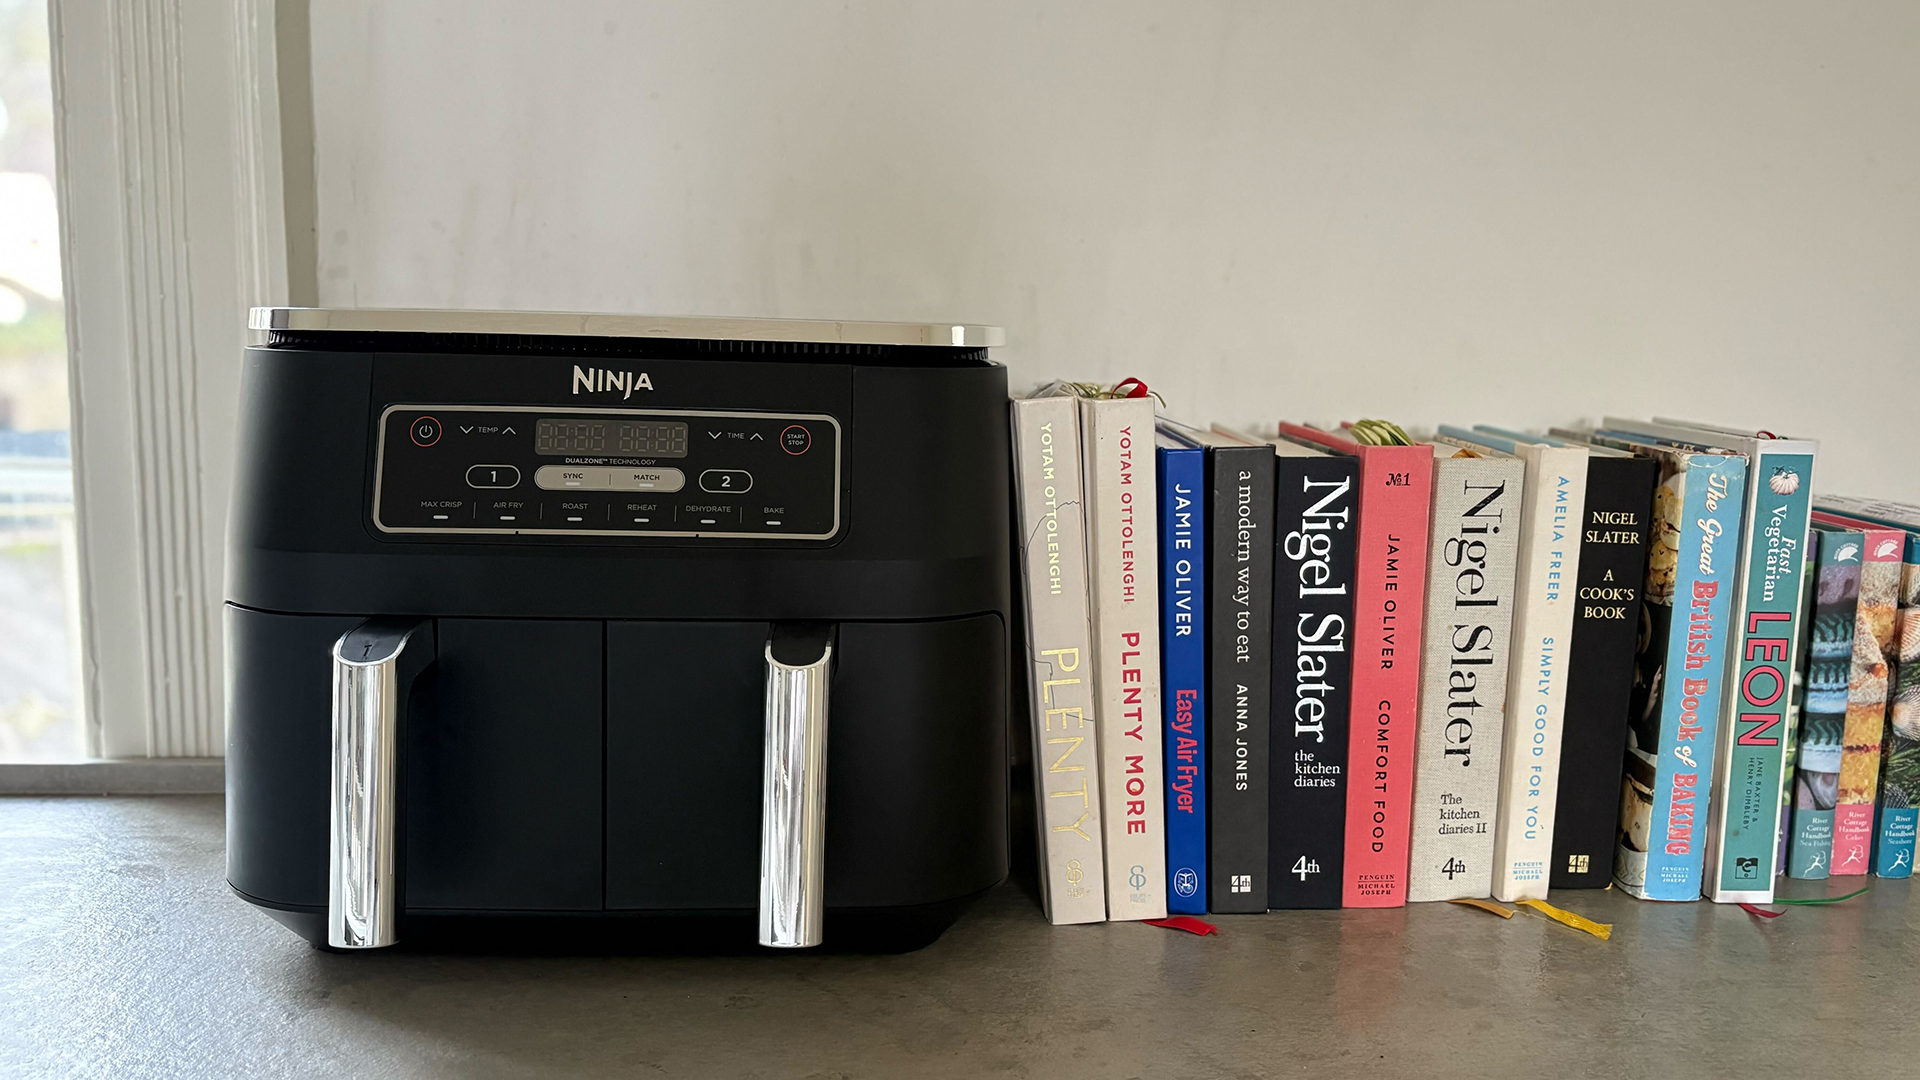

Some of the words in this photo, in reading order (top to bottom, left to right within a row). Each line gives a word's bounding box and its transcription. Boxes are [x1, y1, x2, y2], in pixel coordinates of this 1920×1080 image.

[573, 364, 653, 400] NINJA
[1040, 422, 1055, 480] YOTAM
[1120, 426, 1132, 485] YOTAM
[490, 470, 497, 482] 1
[721, 476, 731, 487] 2
[1239, 470, 1251, 481] a
[1705, 472, 1728, 514] The
[685, 505, 732, 513] DEHYDRATE
[1175, 483, 1192, 550] JAMIE
[1237, 484, 1256, 562] modern
[1552, 476, 1570, 542] AMELIA
[1592, 511, 1638, 526] NIGEL
[1044, 485, 1062, 595] OTTOLENGHI
[1121, 492, 1135, 602] OTTOLENGHI
[1284, 475, 1351, 599] Nigel
[1444, 479, 1506, 611] Nigel
[1585, 530, 1640, 545] SLATER
[1696, 518, 1723, 576] Great
[1762, 504, 1788, 602] Vegetarian
[1778, 535, 1797, 575] Fast
[1232, 566, 1250, 606] way
[1385, 534, 1400, 592] JAMIE
[1546, 551, 1563, 601] FREER
[1603, 568, 1614, 582] A
[1175, 560, 1192, 637] OLIVER
[1580, 586, 1635, 601] COOK'S
[1584, 606, 1626, 620] BOOK
[1236, 610, 1251, 630] to
[1380, 600, 1397, 670] OLIVER
[1684, 580, 1720, 670] British
[1236, 634, 1250, 663] eat
[1537, 637, 1554, 696] SIMPLY
[1121, 632, 1143, 742] PLENTY
[1294, 613, 1346, 744] Slater
[1443, 624, 1494, 767] Slater
[1737, 611, 1792, 746] LEON
[1170, 689, 1197, 734] Easy
[1236, 684, 1248, 732] ANNA
[1532, 704, 1548, 757] GOOD
[1676, 677, 1709, 742] Book
[1041, 647, 1091, 842] PLENTY
[1176, 736, 1198, 763] Air
[1235, 738, 1248, 791] JONES
[1294, 750, 1314, 762] the
[1374, 700, 1392, 793] COMFORT
[1674, 746, 1698, 768] of
[1172, 765, 1198, 814] Fryer
[1294, 776, 1336, 787] diaries
[1295, 762, 1341, 775] kitchen
[1528, 766, 1542, 797] FOR
[1747, 757, 1755, 786] HENRY
[1125, 755, 1146, 835] MORE
[1439, 808, 1480, 820] kitchen
[1440, 794, 1462, 805] The
[1664, 772, 1699, 856] BAKING
[1743, 789, 1752, 830] DIMBLEBY
[1753, 781, 1762, 814] BAXTER
[1371, 801, 1386, 853] FOOD
[1438, 824, 1474, 835] diaries
[1476, 823, 1487, 834] II
[1524, 806, 1539, 840] YOU
[1292, 855, 1320, 881] 4th
[1441, 857, 1466, 880] 4th
